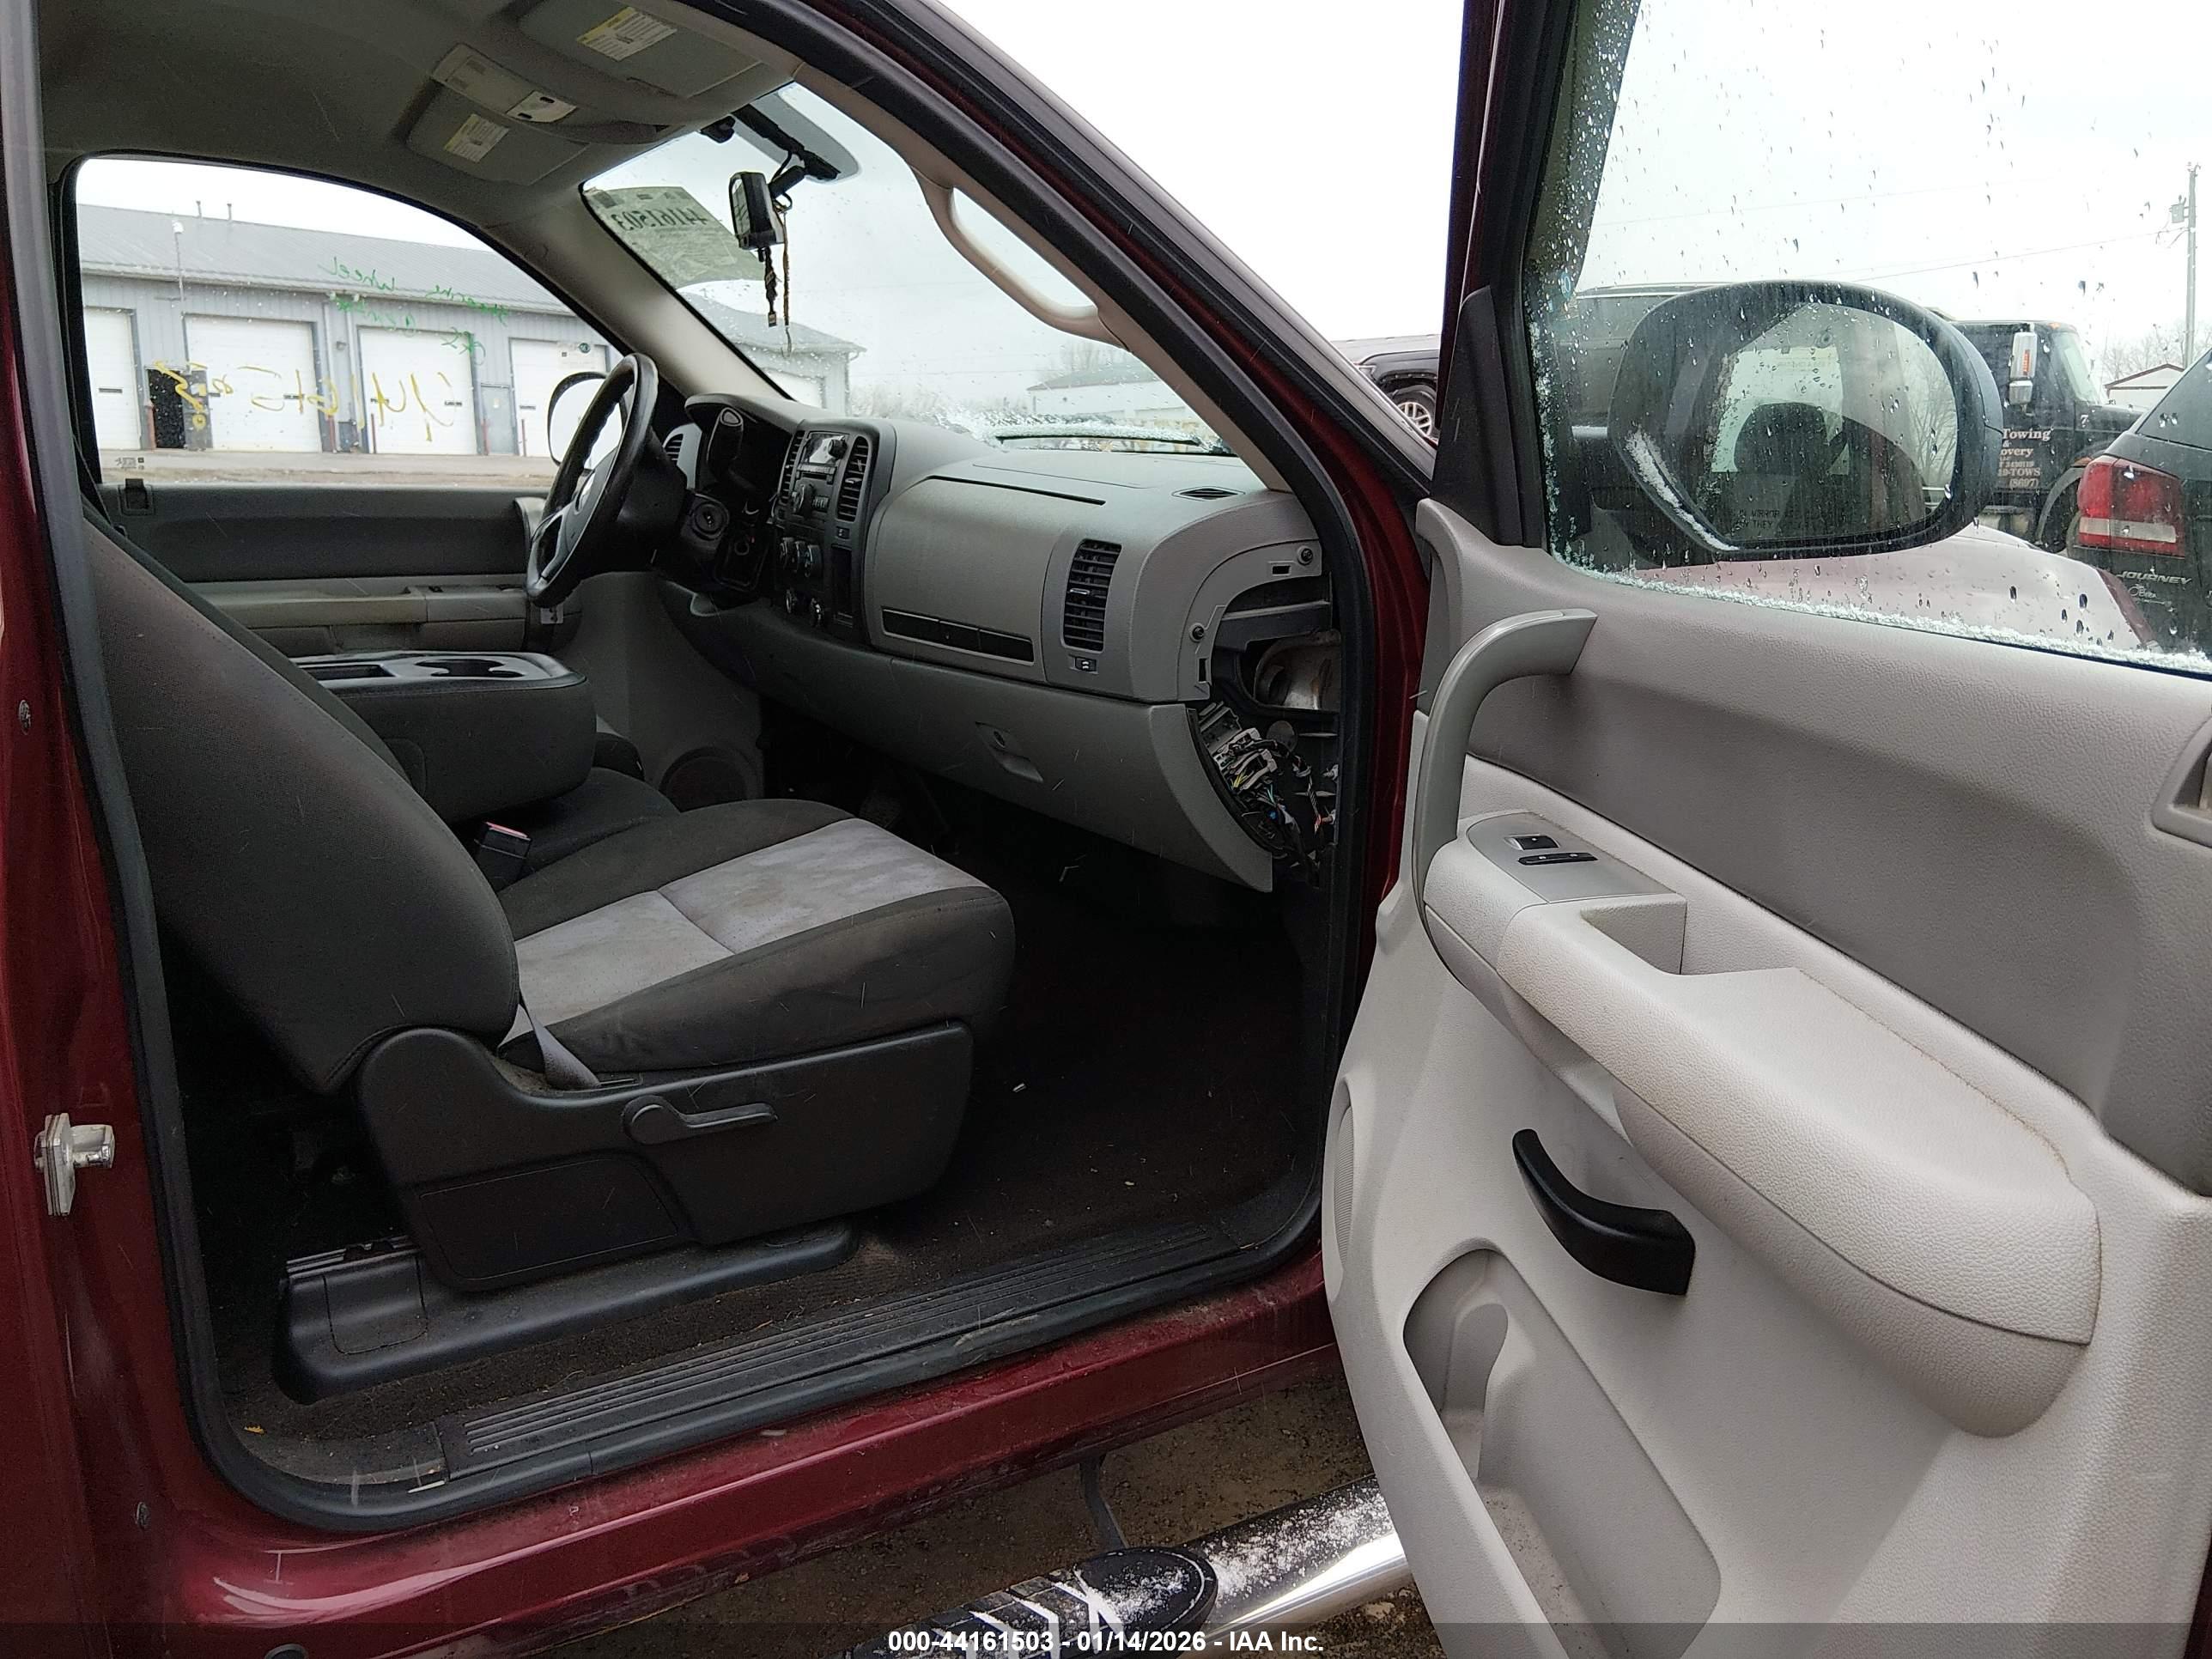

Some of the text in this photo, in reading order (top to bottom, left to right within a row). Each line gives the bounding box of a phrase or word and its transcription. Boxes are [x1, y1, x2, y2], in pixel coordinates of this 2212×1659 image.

[2002, 428, 2051, 441] Towing
[2000, 447, 2034, 458] overy
[2116, 570, 2192, 585] JOURNEY
